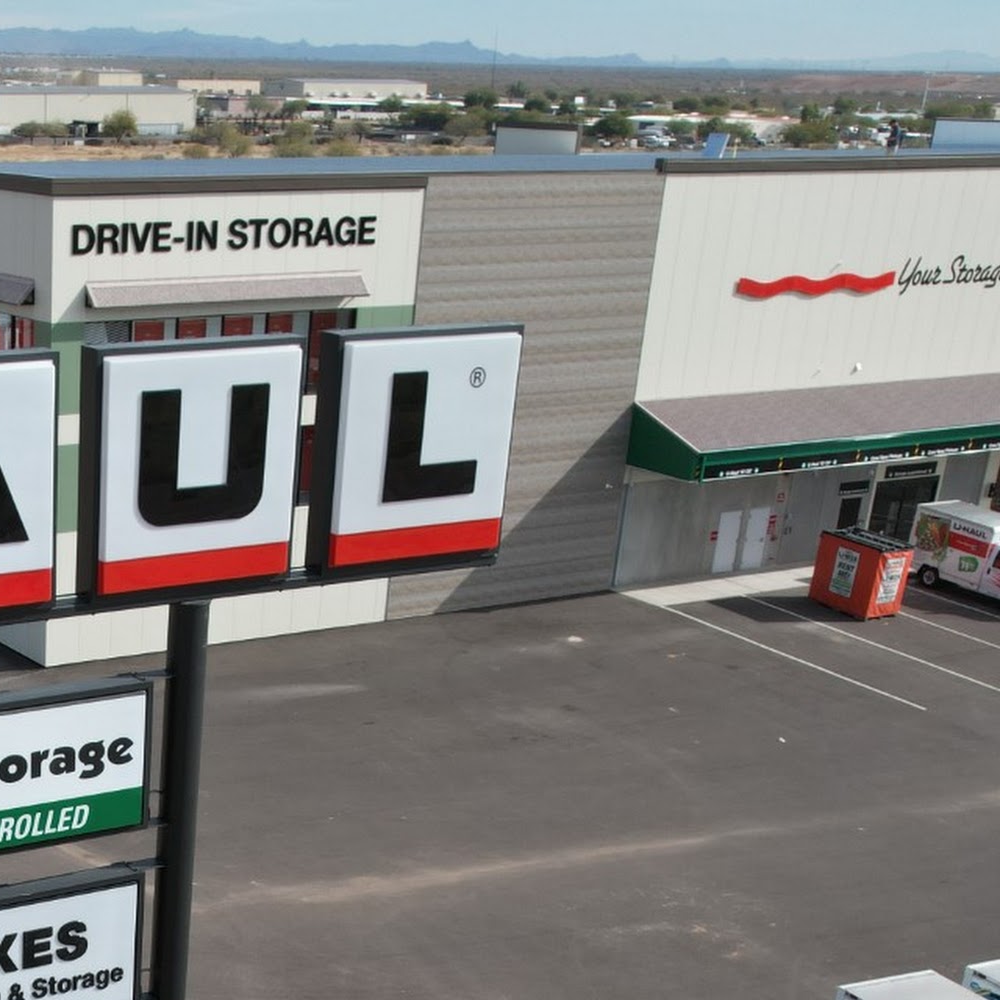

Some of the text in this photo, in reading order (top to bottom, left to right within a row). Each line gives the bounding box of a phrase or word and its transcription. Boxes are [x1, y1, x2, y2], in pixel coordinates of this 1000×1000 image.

[71, 215, 378, 257] DRIVE-IN STORAGE
[898, 254, 1000, 295] Your Storag
[31, 966, 124, 1000] Storage
